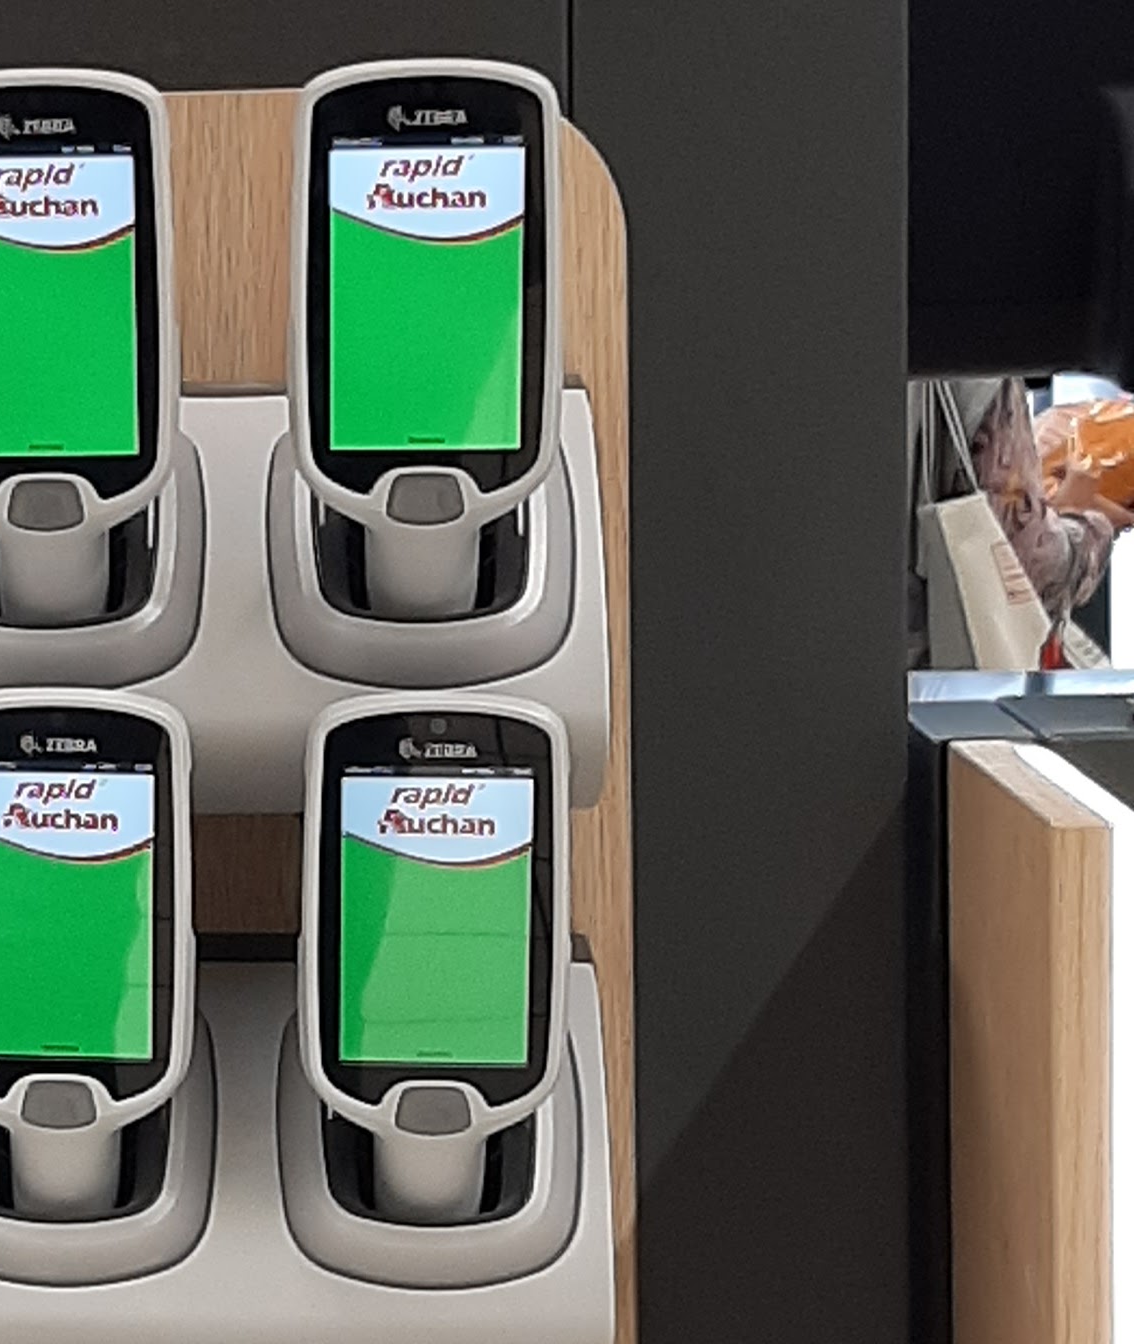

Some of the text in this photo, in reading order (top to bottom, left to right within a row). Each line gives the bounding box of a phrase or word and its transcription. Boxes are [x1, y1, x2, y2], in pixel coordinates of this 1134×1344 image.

[367, 183, 487, 210] Auchan
[46, 737, 97, 754] ZEBRA
[2, 803, 118, 831] Auchan
[378, 809, 495, 836] Auchan
